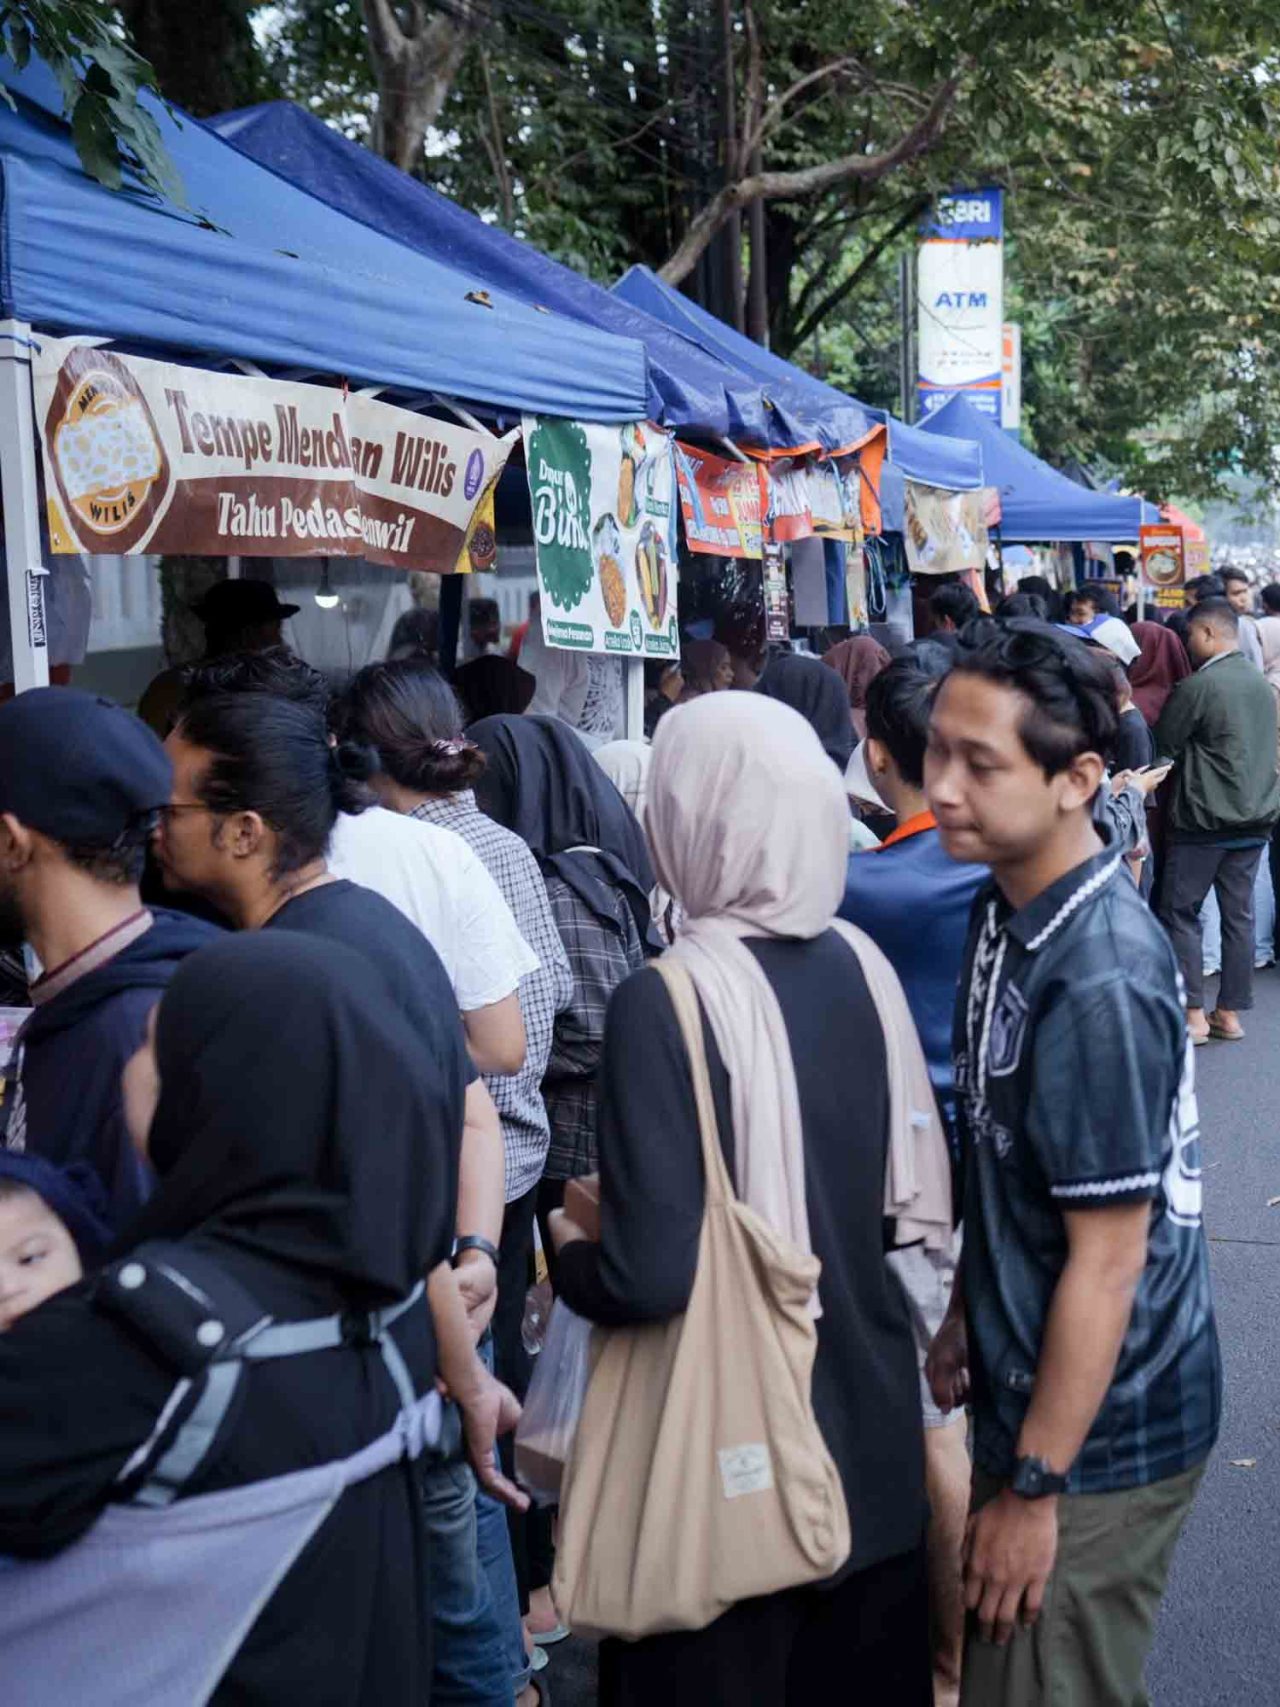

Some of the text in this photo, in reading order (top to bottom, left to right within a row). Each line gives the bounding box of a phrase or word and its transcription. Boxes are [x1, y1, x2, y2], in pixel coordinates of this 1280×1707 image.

[954, 199, 991, 223] BRI
[935, 291, 987, 308] ATM
[164, 388, 273, 470] Tempe
[390, 431, 458, 498] Wilis
[90, 491, 136, 523] WILIS
[217, 492, 277, 537] Tahu
